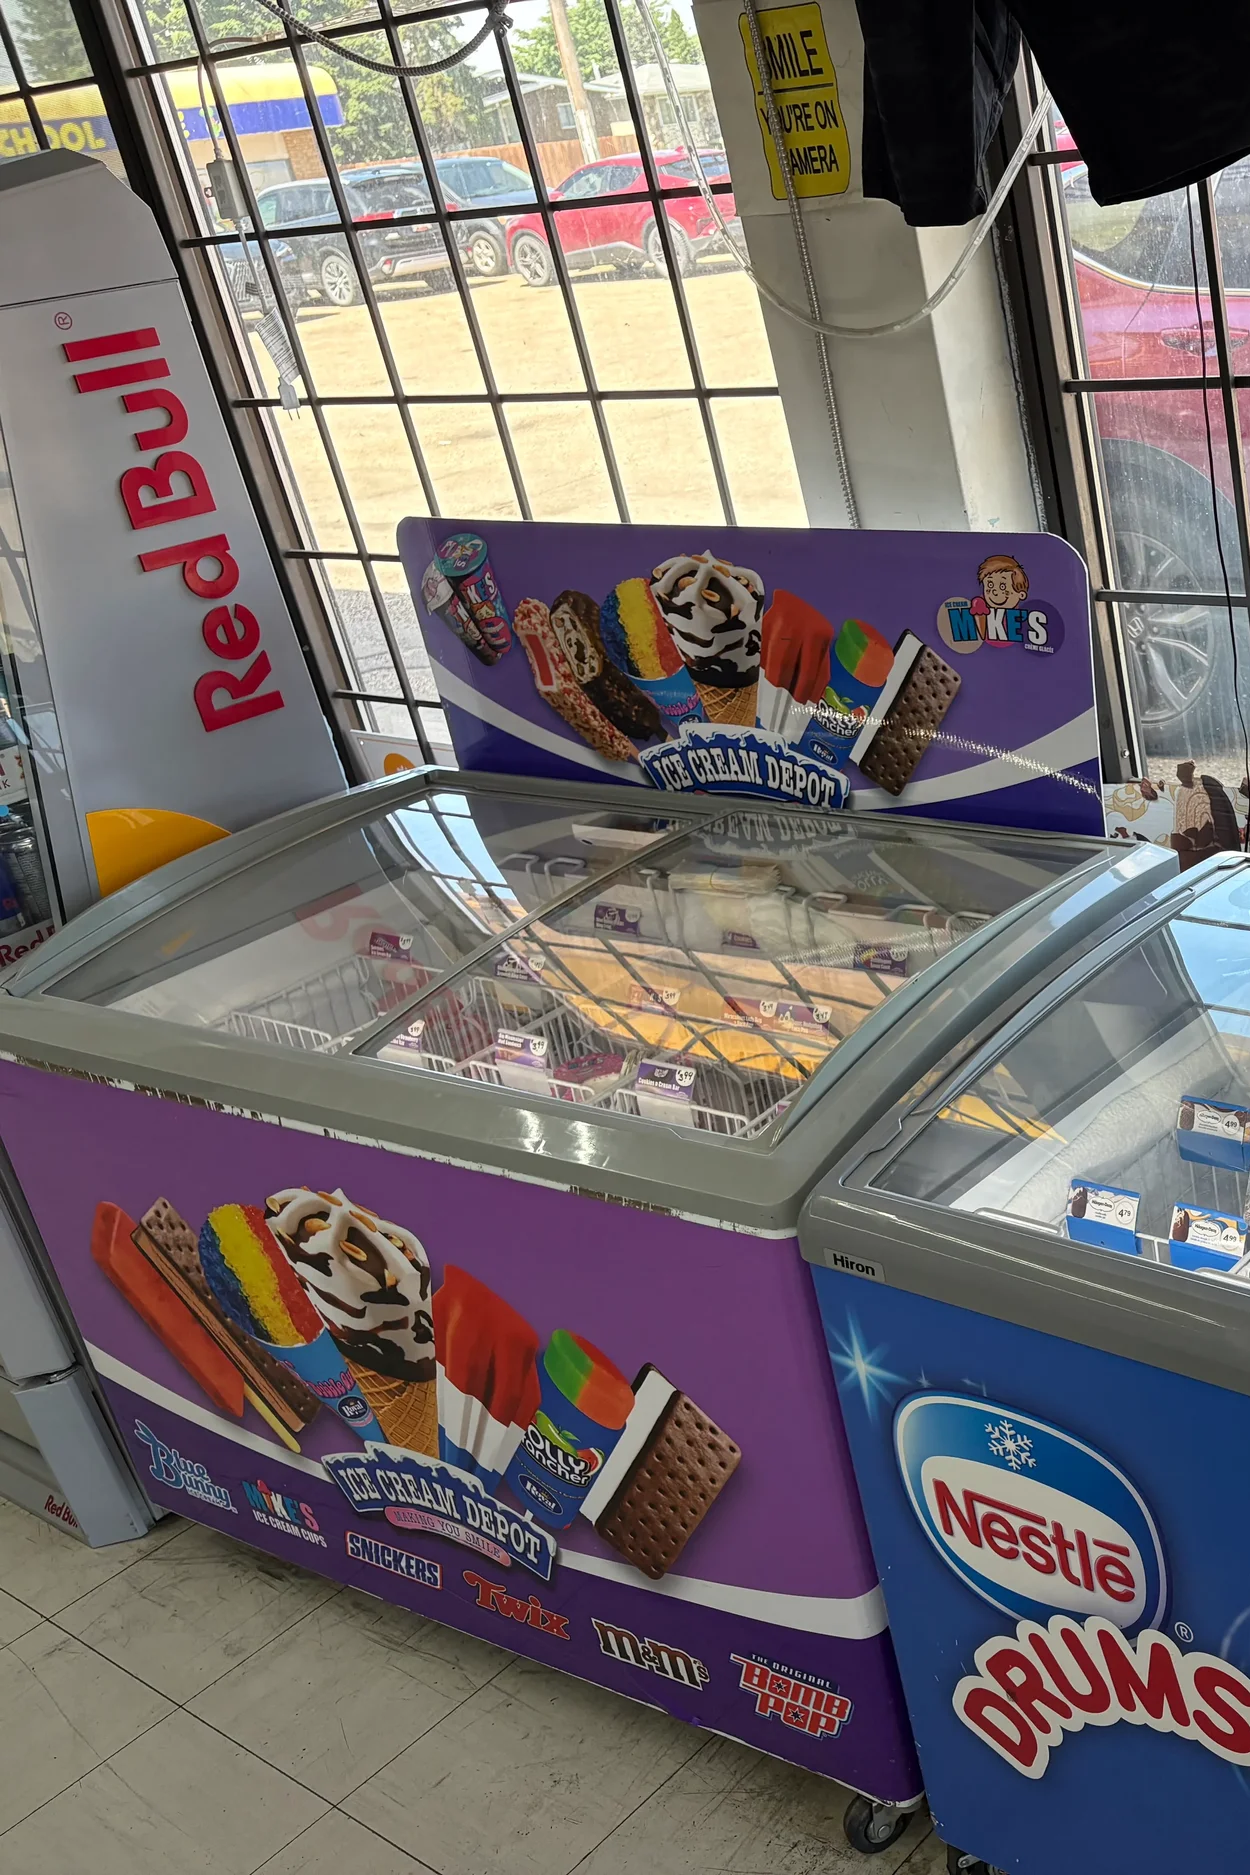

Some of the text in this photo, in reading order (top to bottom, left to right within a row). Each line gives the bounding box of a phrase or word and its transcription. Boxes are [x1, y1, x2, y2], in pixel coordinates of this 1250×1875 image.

[759, 30, 823, 80] MILE
[760, 100, 839, 136] YU'RE ON
[789, 144, 839, 176] AMERA
[62, 326, 285, 733] Red Bull
[948, 607, 1048, 645] MIKE'S
[653, 748, 836, 808] ICE CREAM DEPOT
[1118, 1208, 1131, 1218] 479
[832, 1253, 876, 1277] Hiron
[341, 1400, 364, 1418] Royal
[242, 1480, 320, 1532] MIKE'S
[525, 1480, 557, 1510] Royal
[62, 1506, 78, 1528] Bu
[253, 1509, 328, 1548] ICE CREAM CUPS
[338, 1468, 380, 1501] ICE
[375, 1468, 461, 1520] CREAM
[462, 1495, 541, 1564] DEPOT
[393, 1510, 501, 1558] MAKING YOU SMILE
[348, 1533, 439, 1588] SNICKERS
[462, 1570, 571, 1640] Twix
[751, 1653, 833, 1690] THE ORIGINAL
[756, 1691, 842, 1738] POP
